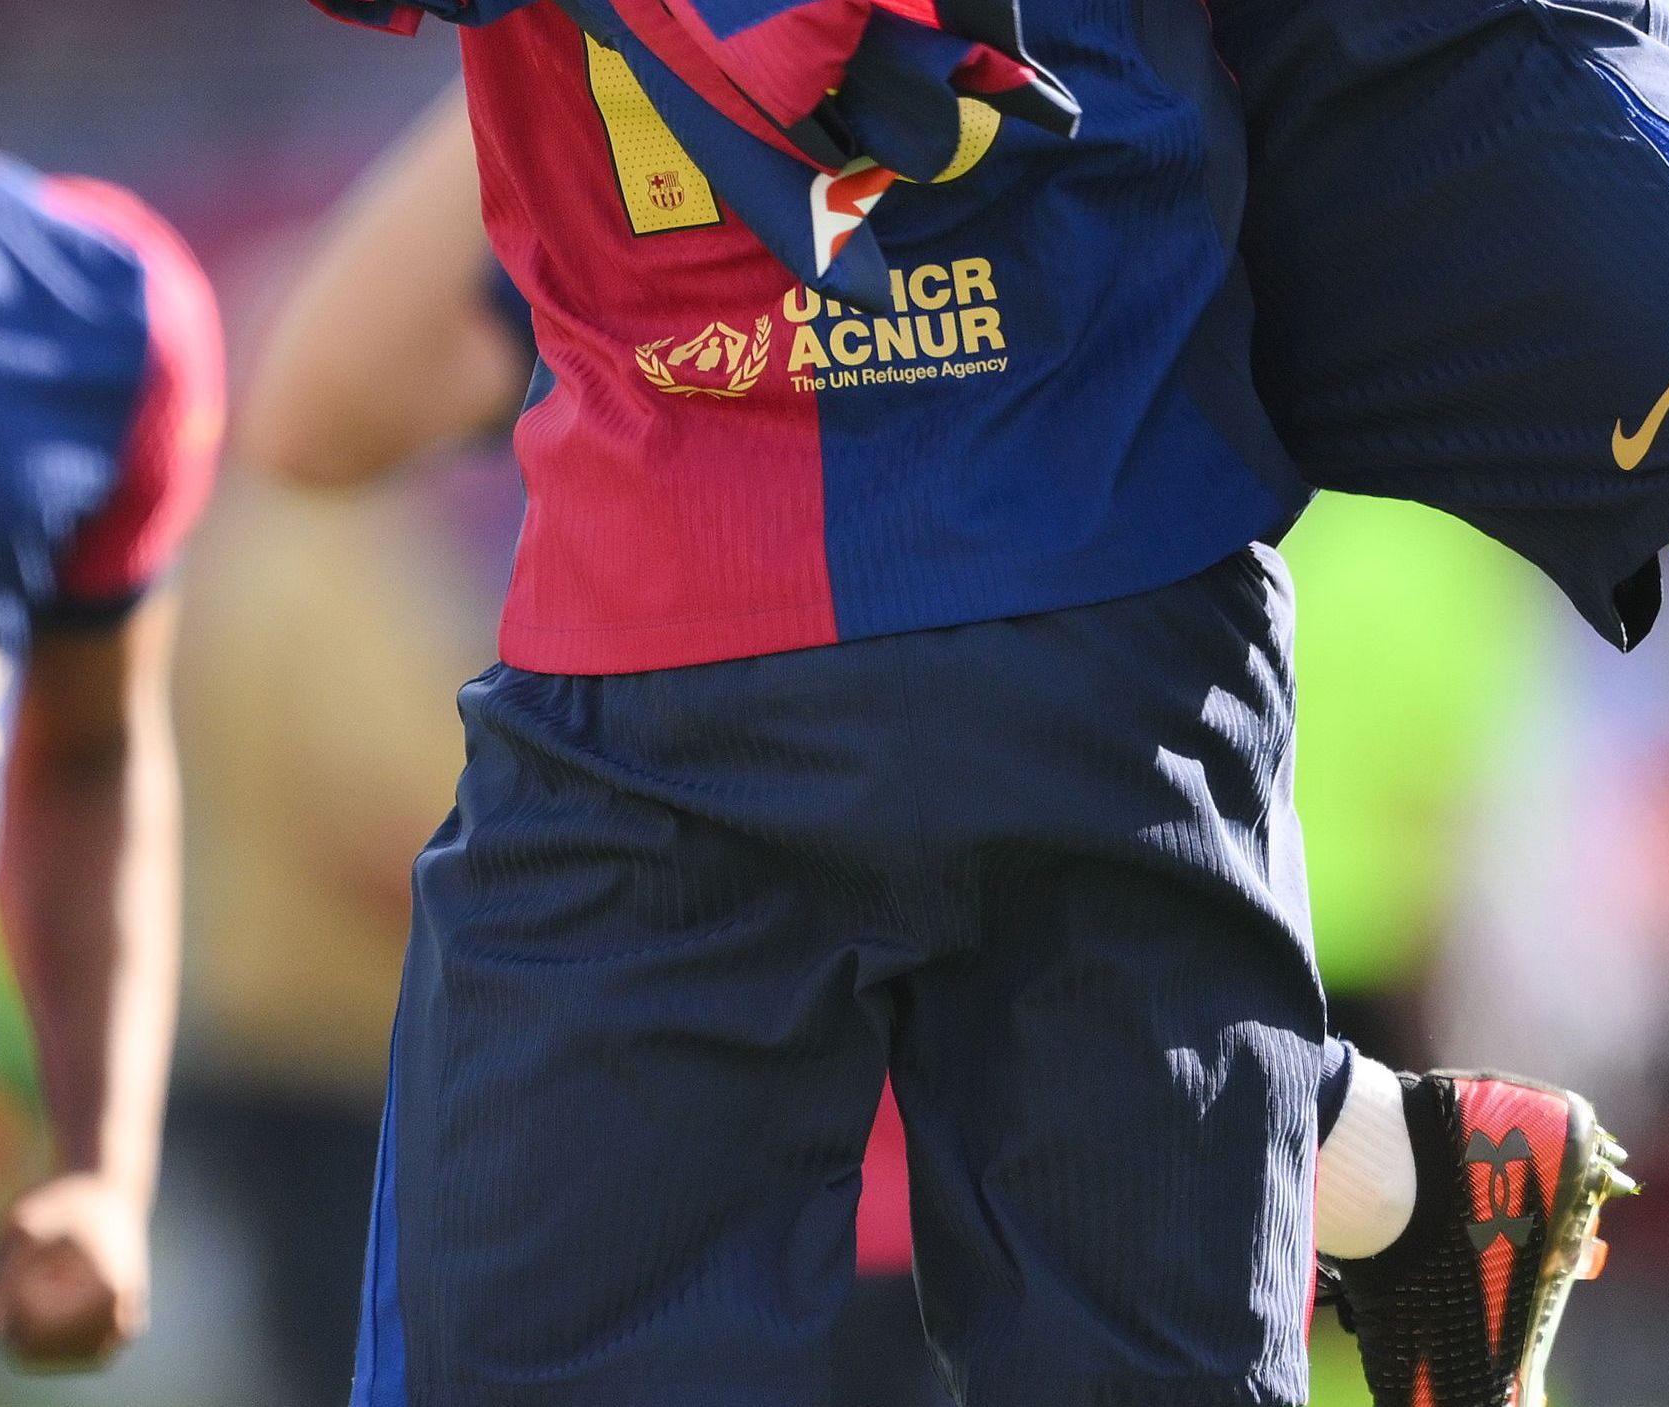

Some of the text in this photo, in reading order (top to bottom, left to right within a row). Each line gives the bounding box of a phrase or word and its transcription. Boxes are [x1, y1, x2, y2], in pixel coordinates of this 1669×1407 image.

[787, 306, 1006, 372] ACNUR
[790, 357, 1009, 393] The UN Refugee Agency
